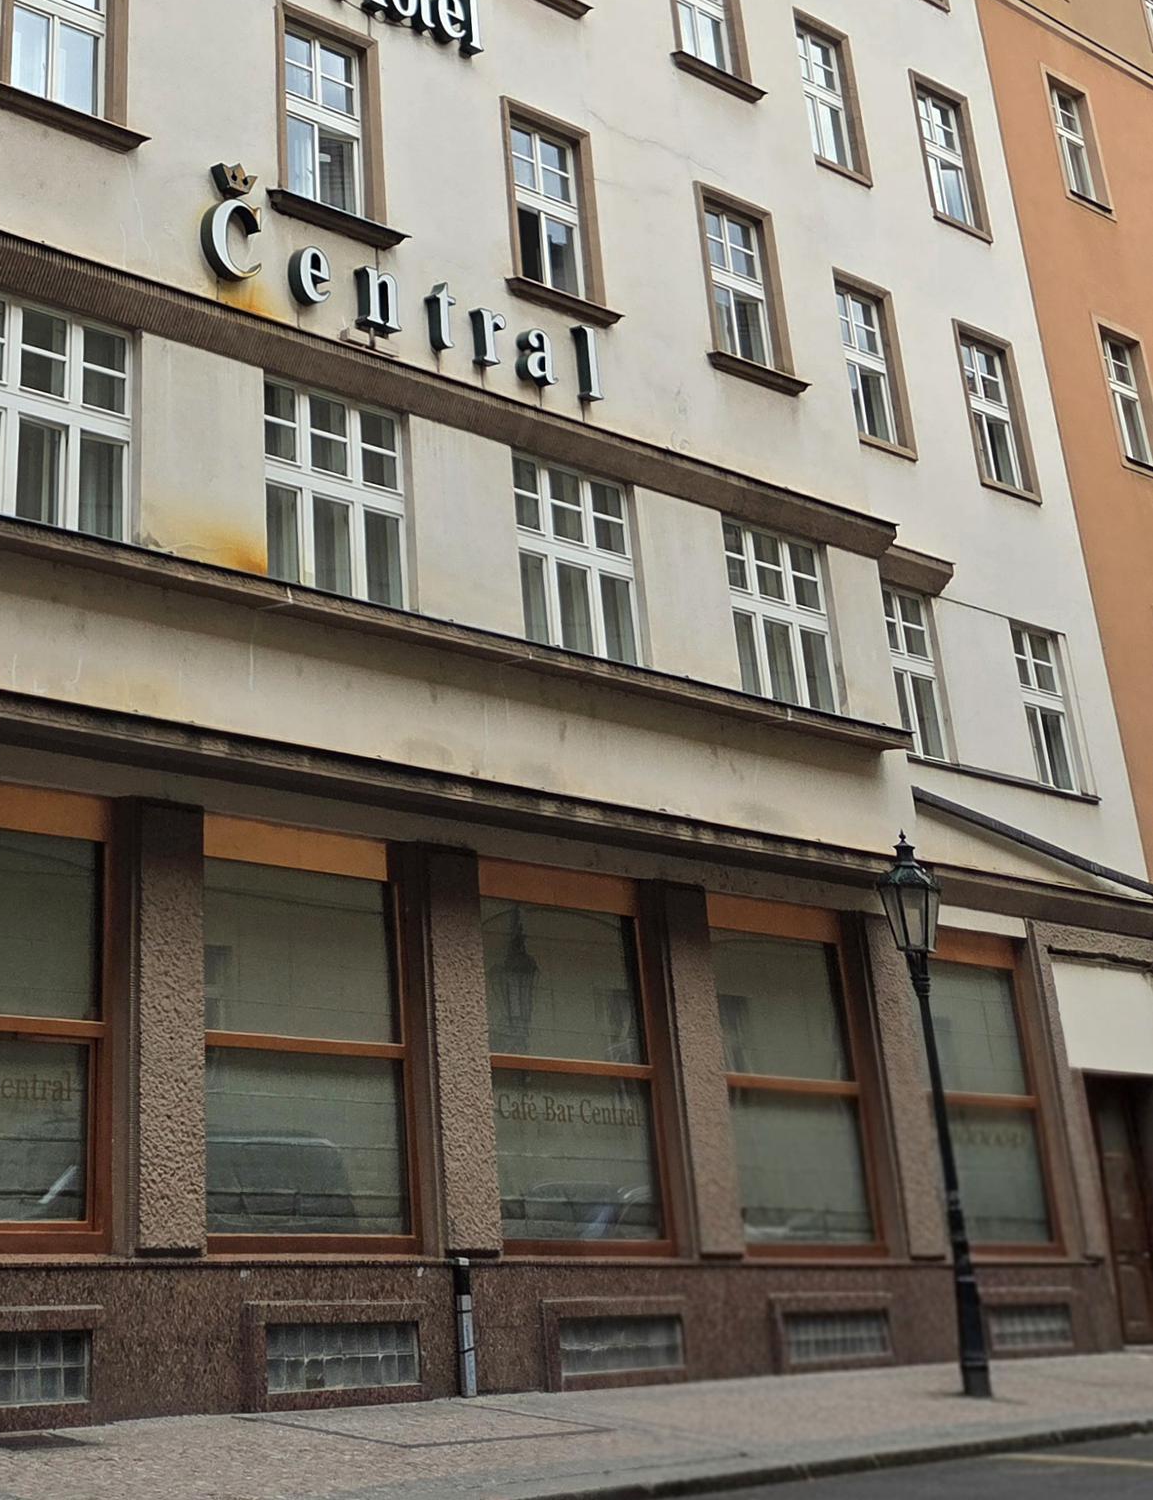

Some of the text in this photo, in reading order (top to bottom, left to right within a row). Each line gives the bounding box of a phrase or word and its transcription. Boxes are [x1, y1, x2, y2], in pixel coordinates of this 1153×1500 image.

[200, 198, 604, 401] Central
[498, 1093, 641, 1127] Café Bar Central
